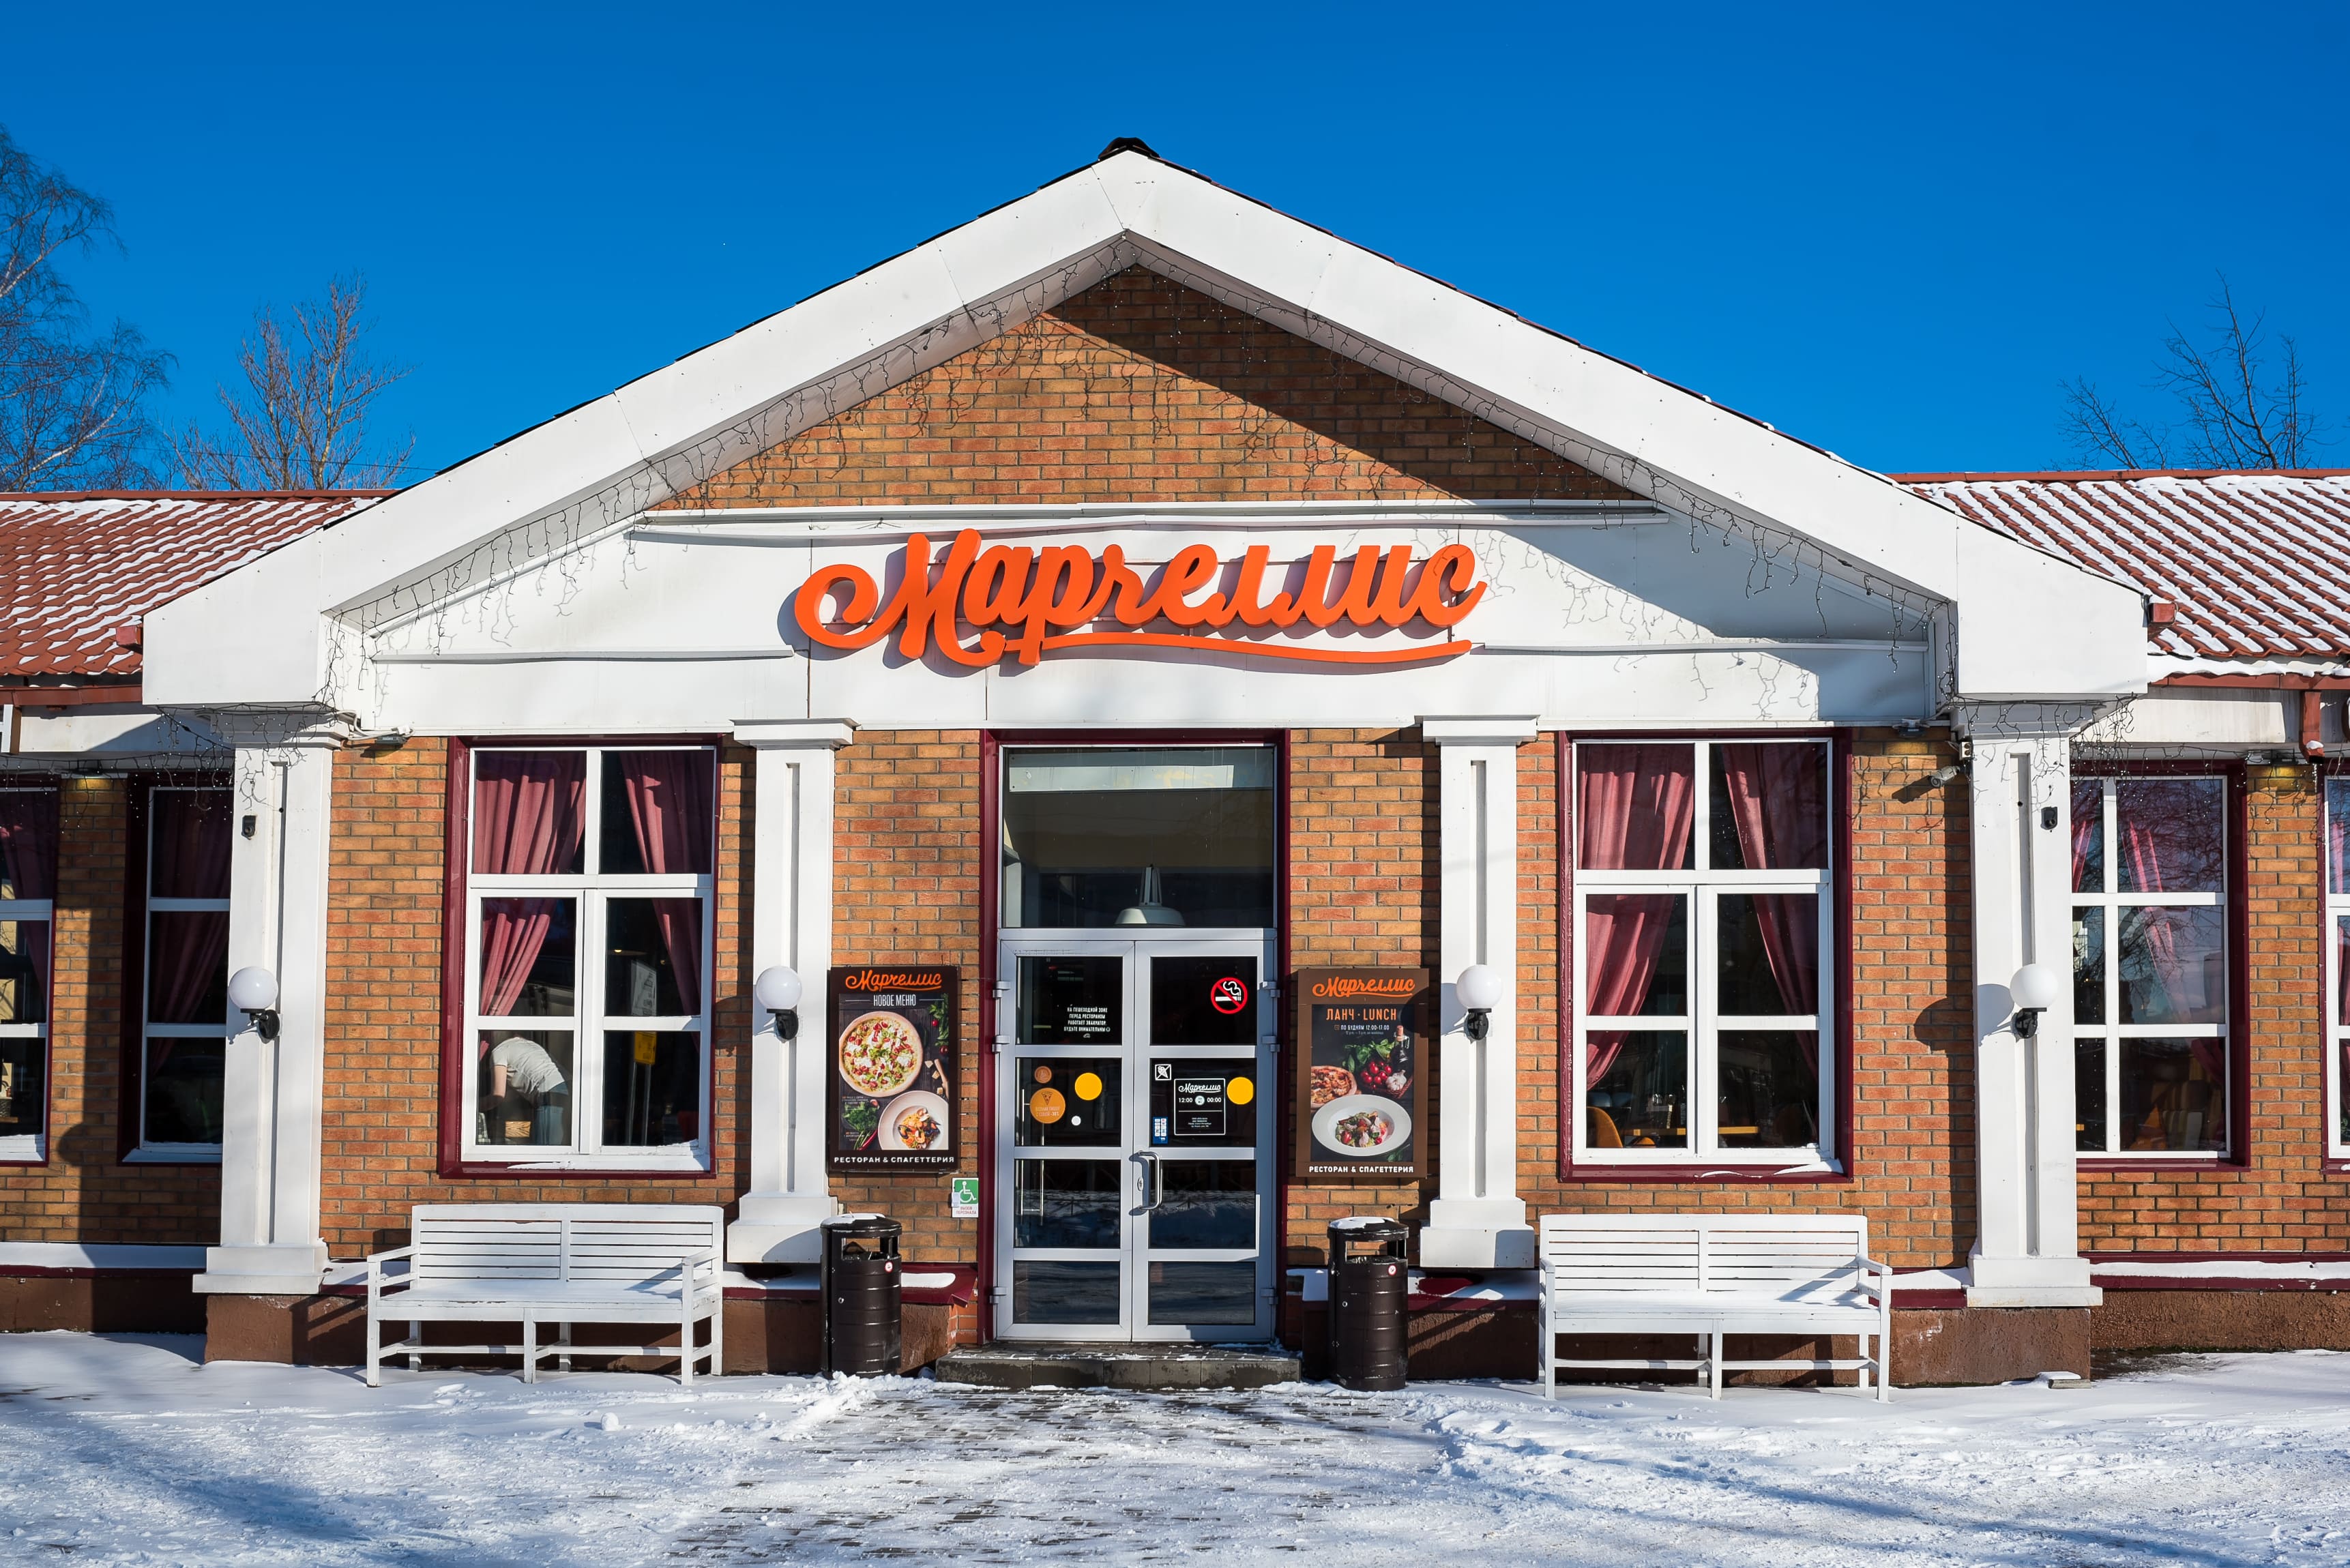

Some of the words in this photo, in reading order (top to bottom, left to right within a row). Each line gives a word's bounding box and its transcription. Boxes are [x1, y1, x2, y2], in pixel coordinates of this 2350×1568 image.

[795, 528, 1486, 666] Марчеллис
[845, 969, 942, 992] Марчеллис
[1312, 976, 1415, 998] Марчеллис
[873, 994, 894, 1007] НОВОЕ
[896, 994, 916, 1007] МЕНЮ
[1325, 1008, 1354, 1021] ЛАНЧ
[1363, 1008, 1396, 1021] LUNCH
[1178, 1082, 1222, 1093] Марчеллис
